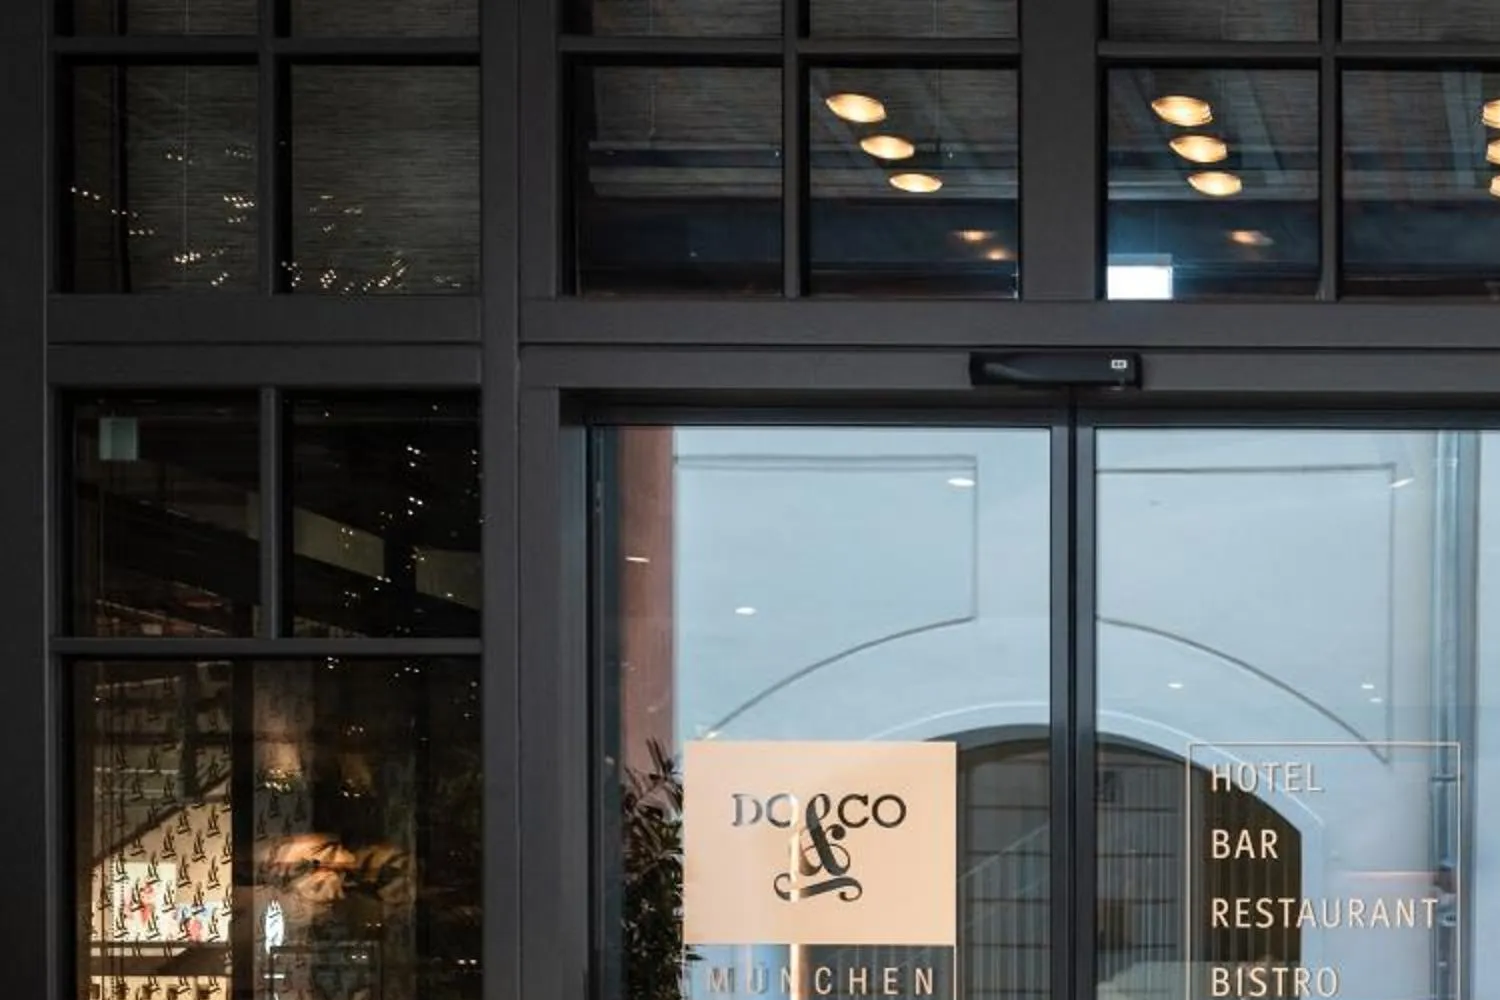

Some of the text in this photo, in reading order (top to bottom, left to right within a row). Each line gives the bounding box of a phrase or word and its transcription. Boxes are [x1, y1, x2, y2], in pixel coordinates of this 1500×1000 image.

[1211, 762, 1324, 793] HOTEL
[1212, 829, 1279, 860] BAR
[1212, 897, 1439, 929] RESTAURANT
[1211, 967, 1340, 998] BISTRO
